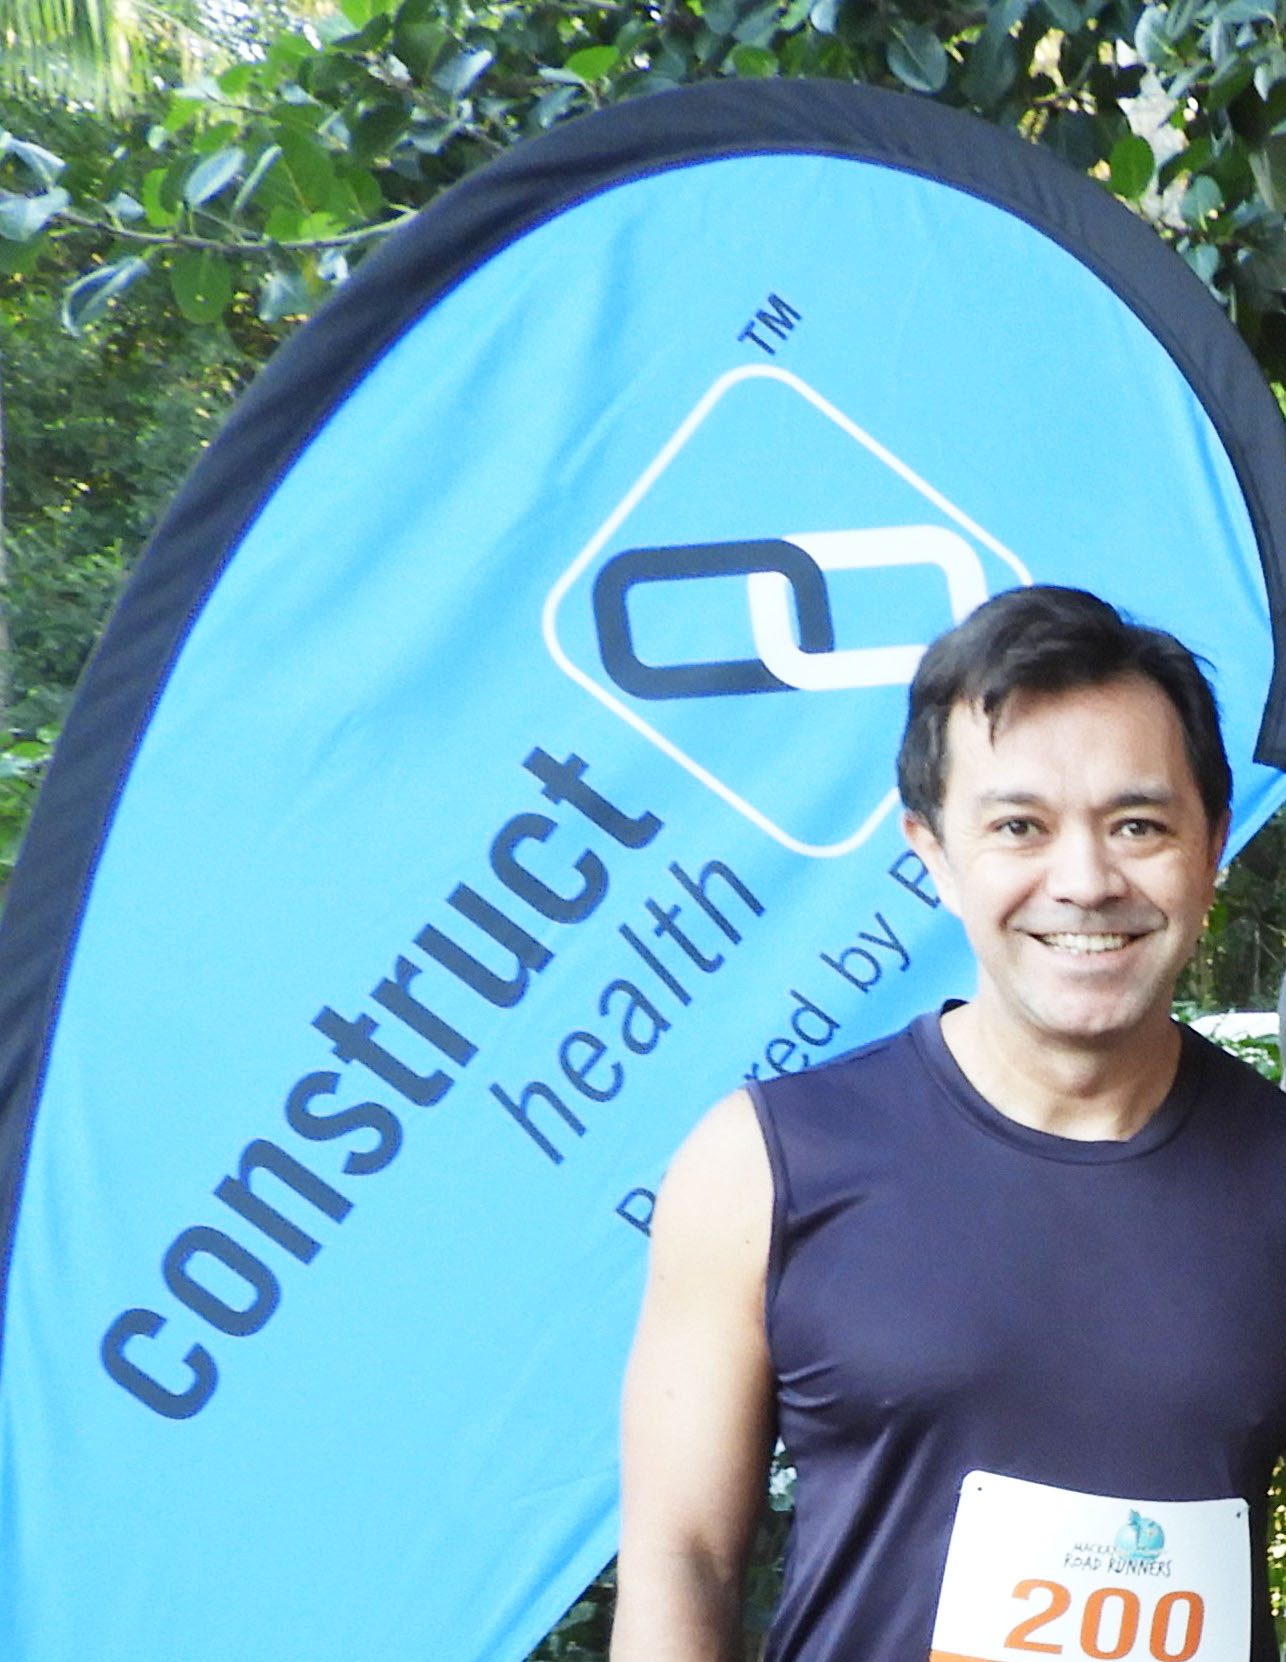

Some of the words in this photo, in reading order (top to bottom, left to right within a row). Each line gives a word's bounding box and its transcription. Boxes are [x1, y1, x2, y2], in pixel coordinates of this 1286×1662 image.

[736, 293, 804, 358] TM
[820, 912, 911, 993] by
[491, 857, 766, 1166] health
[100, 745, 663, 1420] construct
[1107, 1557, 1173, 1578] RUNNERS
